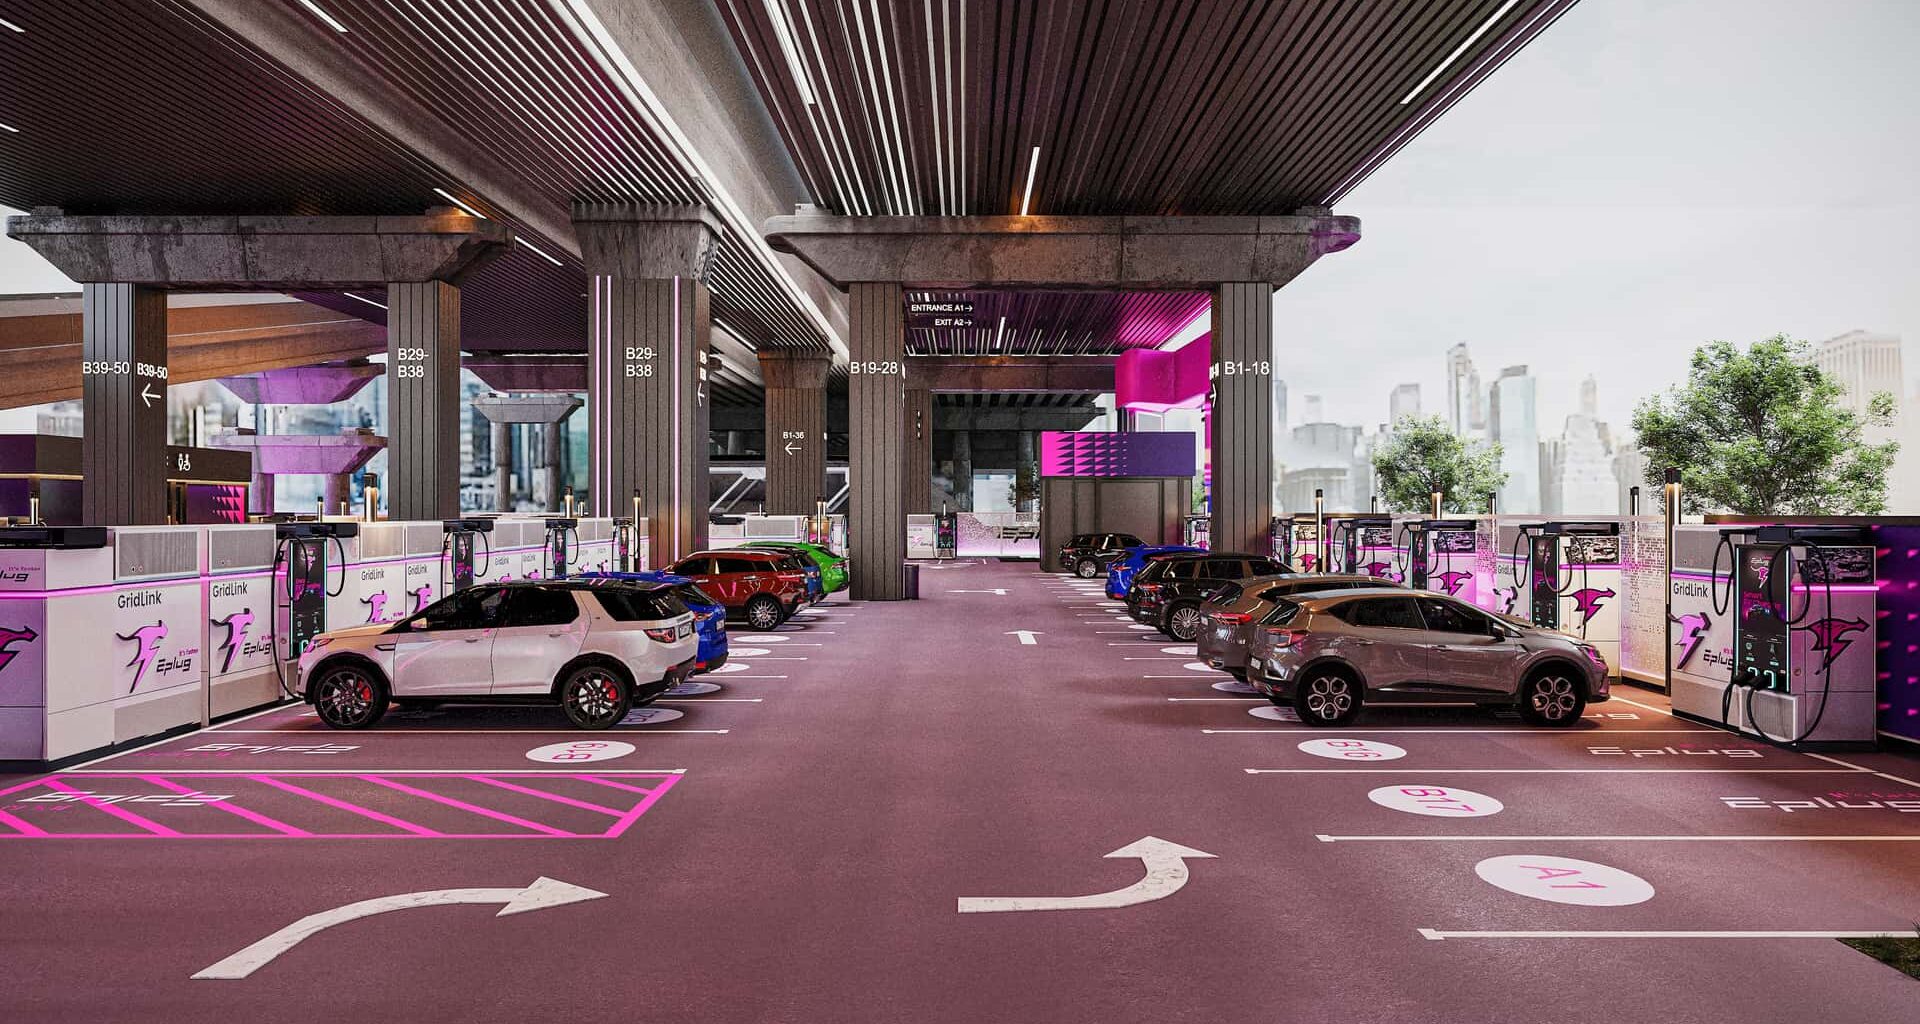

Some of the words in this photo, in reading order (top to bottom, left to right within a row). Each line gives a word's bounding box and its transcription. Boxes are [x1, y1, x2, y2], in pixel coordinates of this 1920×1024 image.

[911, 304, 953, 312] ENTRANCE
[954, 304, 964, 312] A1
[953, 318, 964, 326] A2
[398, 348, 429, 360] B29-
[626, 347, 658, 360] B29-
[82, 361, 130, 374] B39-50
[137, 362, 168, 379] B39-50
[398, 365, 424, 378] B38
[626, 364, 652, 377] B38
[850, 361, 898, 374] B19-28
[1224, 361, 1270, 375] B1-18
[361, 569, 385, 582] GridLink
[408, 564, 428, 576] GridLink
[212, 582, 248, 598] GridLink
[1673, 583, 1708, 598] GridLink
[117, 590, 162, 609] GridLink
[156, 657, 192, 676] Eplug
[1400, 788, 1476, 813] B17
[1519, 864, 1608, 889] A1
